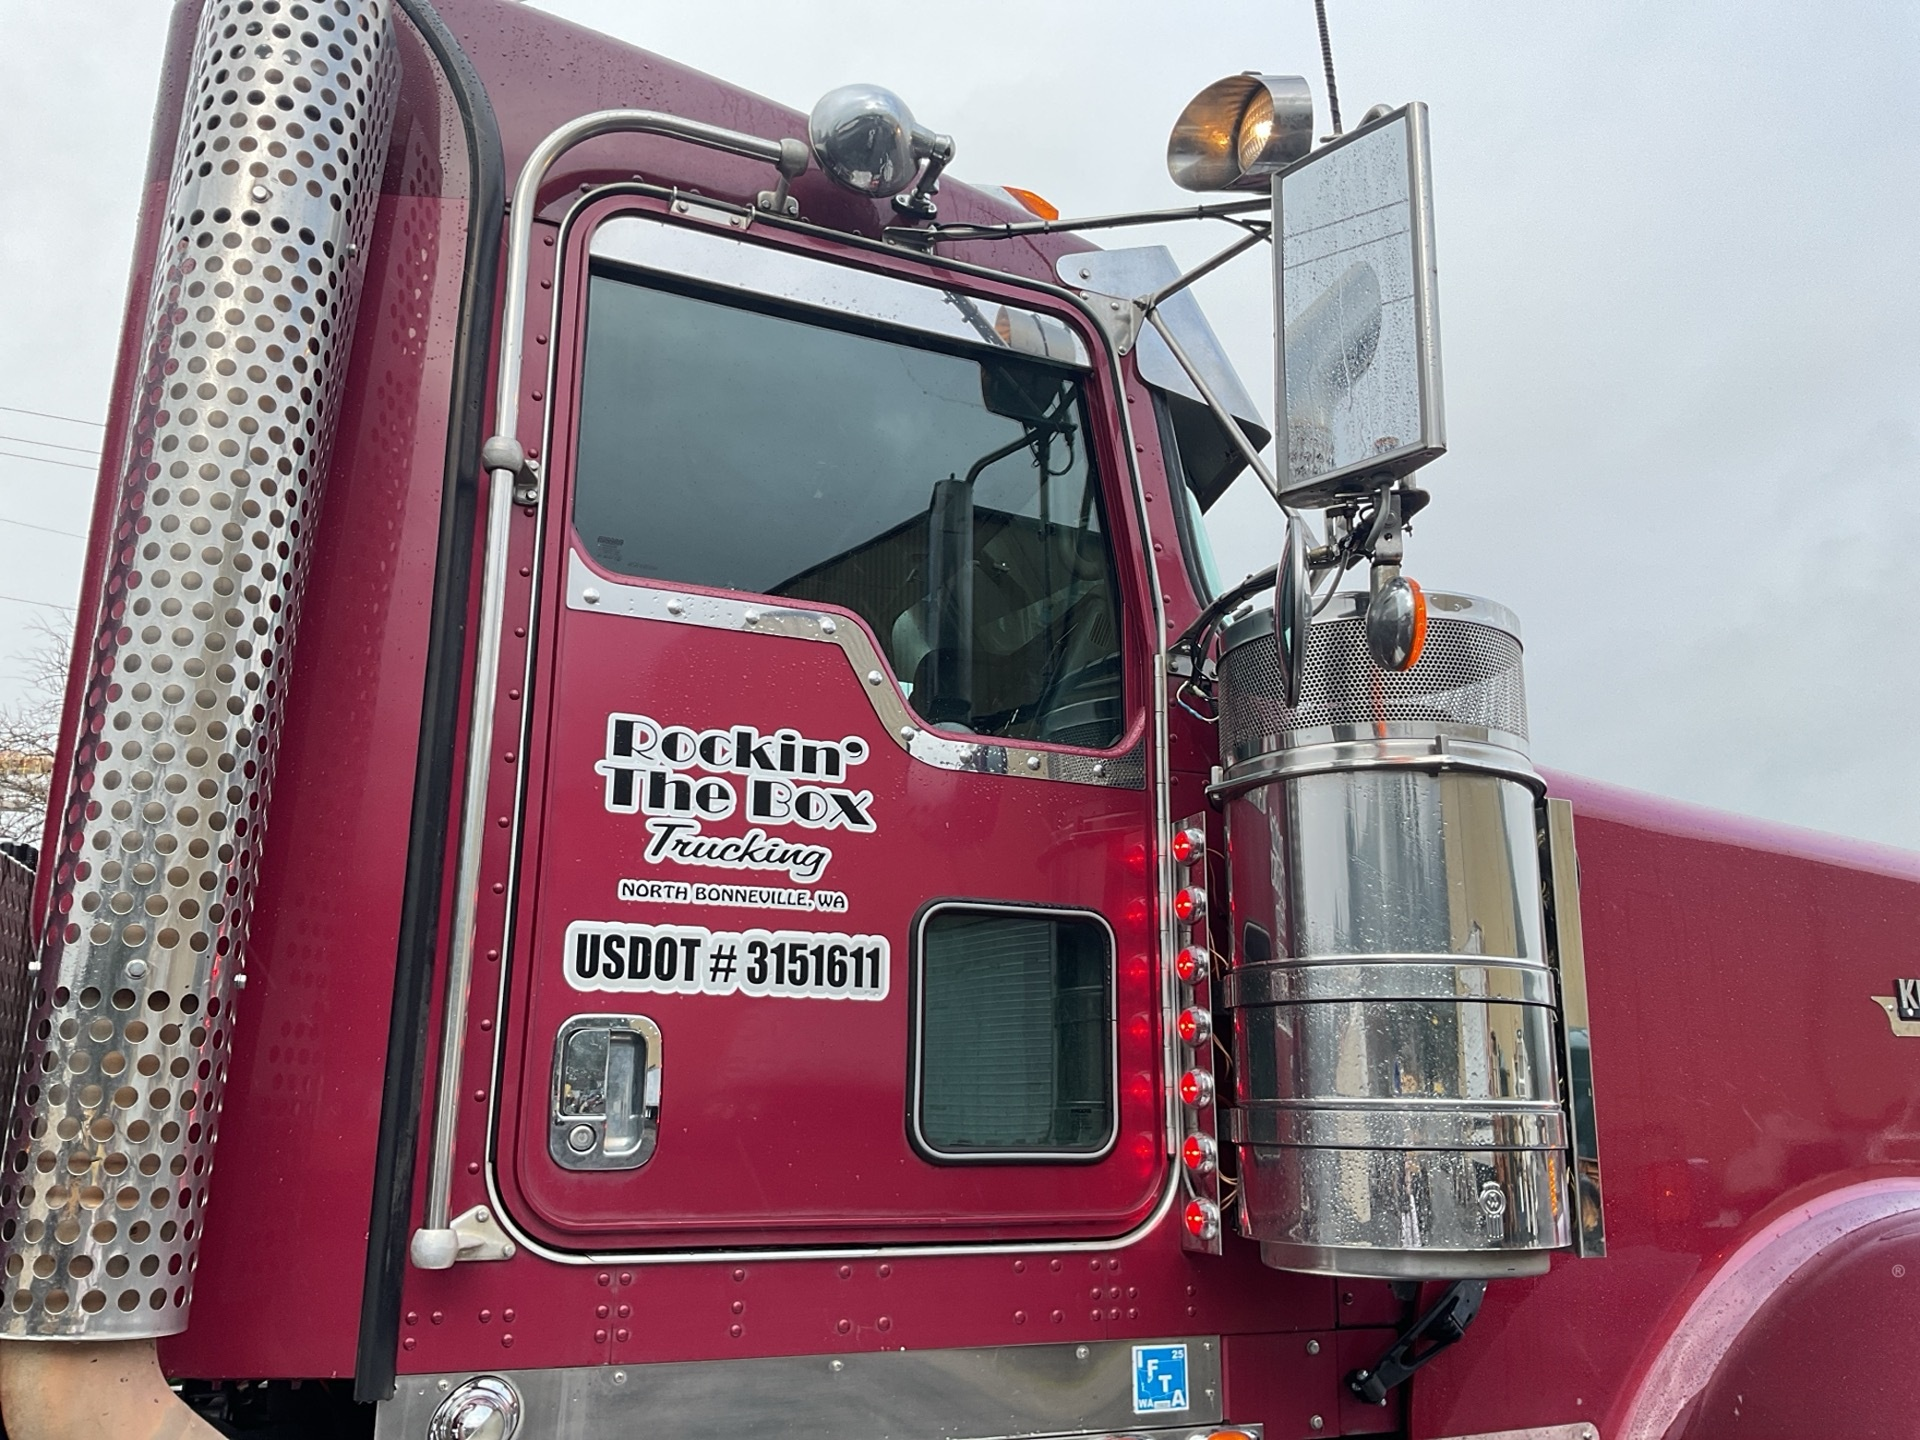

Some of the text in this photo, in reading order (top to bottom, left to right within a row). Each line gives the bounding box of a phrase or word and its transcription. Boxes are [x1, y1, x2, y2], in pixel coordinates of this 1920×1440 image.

[612, 718, 864, 777] Rockin'
[602, 765, 731, 814] The
[649, 822, 827, 877] Trucking
[621, 882, 847, 910] NORTH BONNEVILLE, WA
[575, 932, 881, 989] USDOT # 3151611
[1898, 978, 1920, 1010] K
[1138, 1399, 1154, 1408] WA
